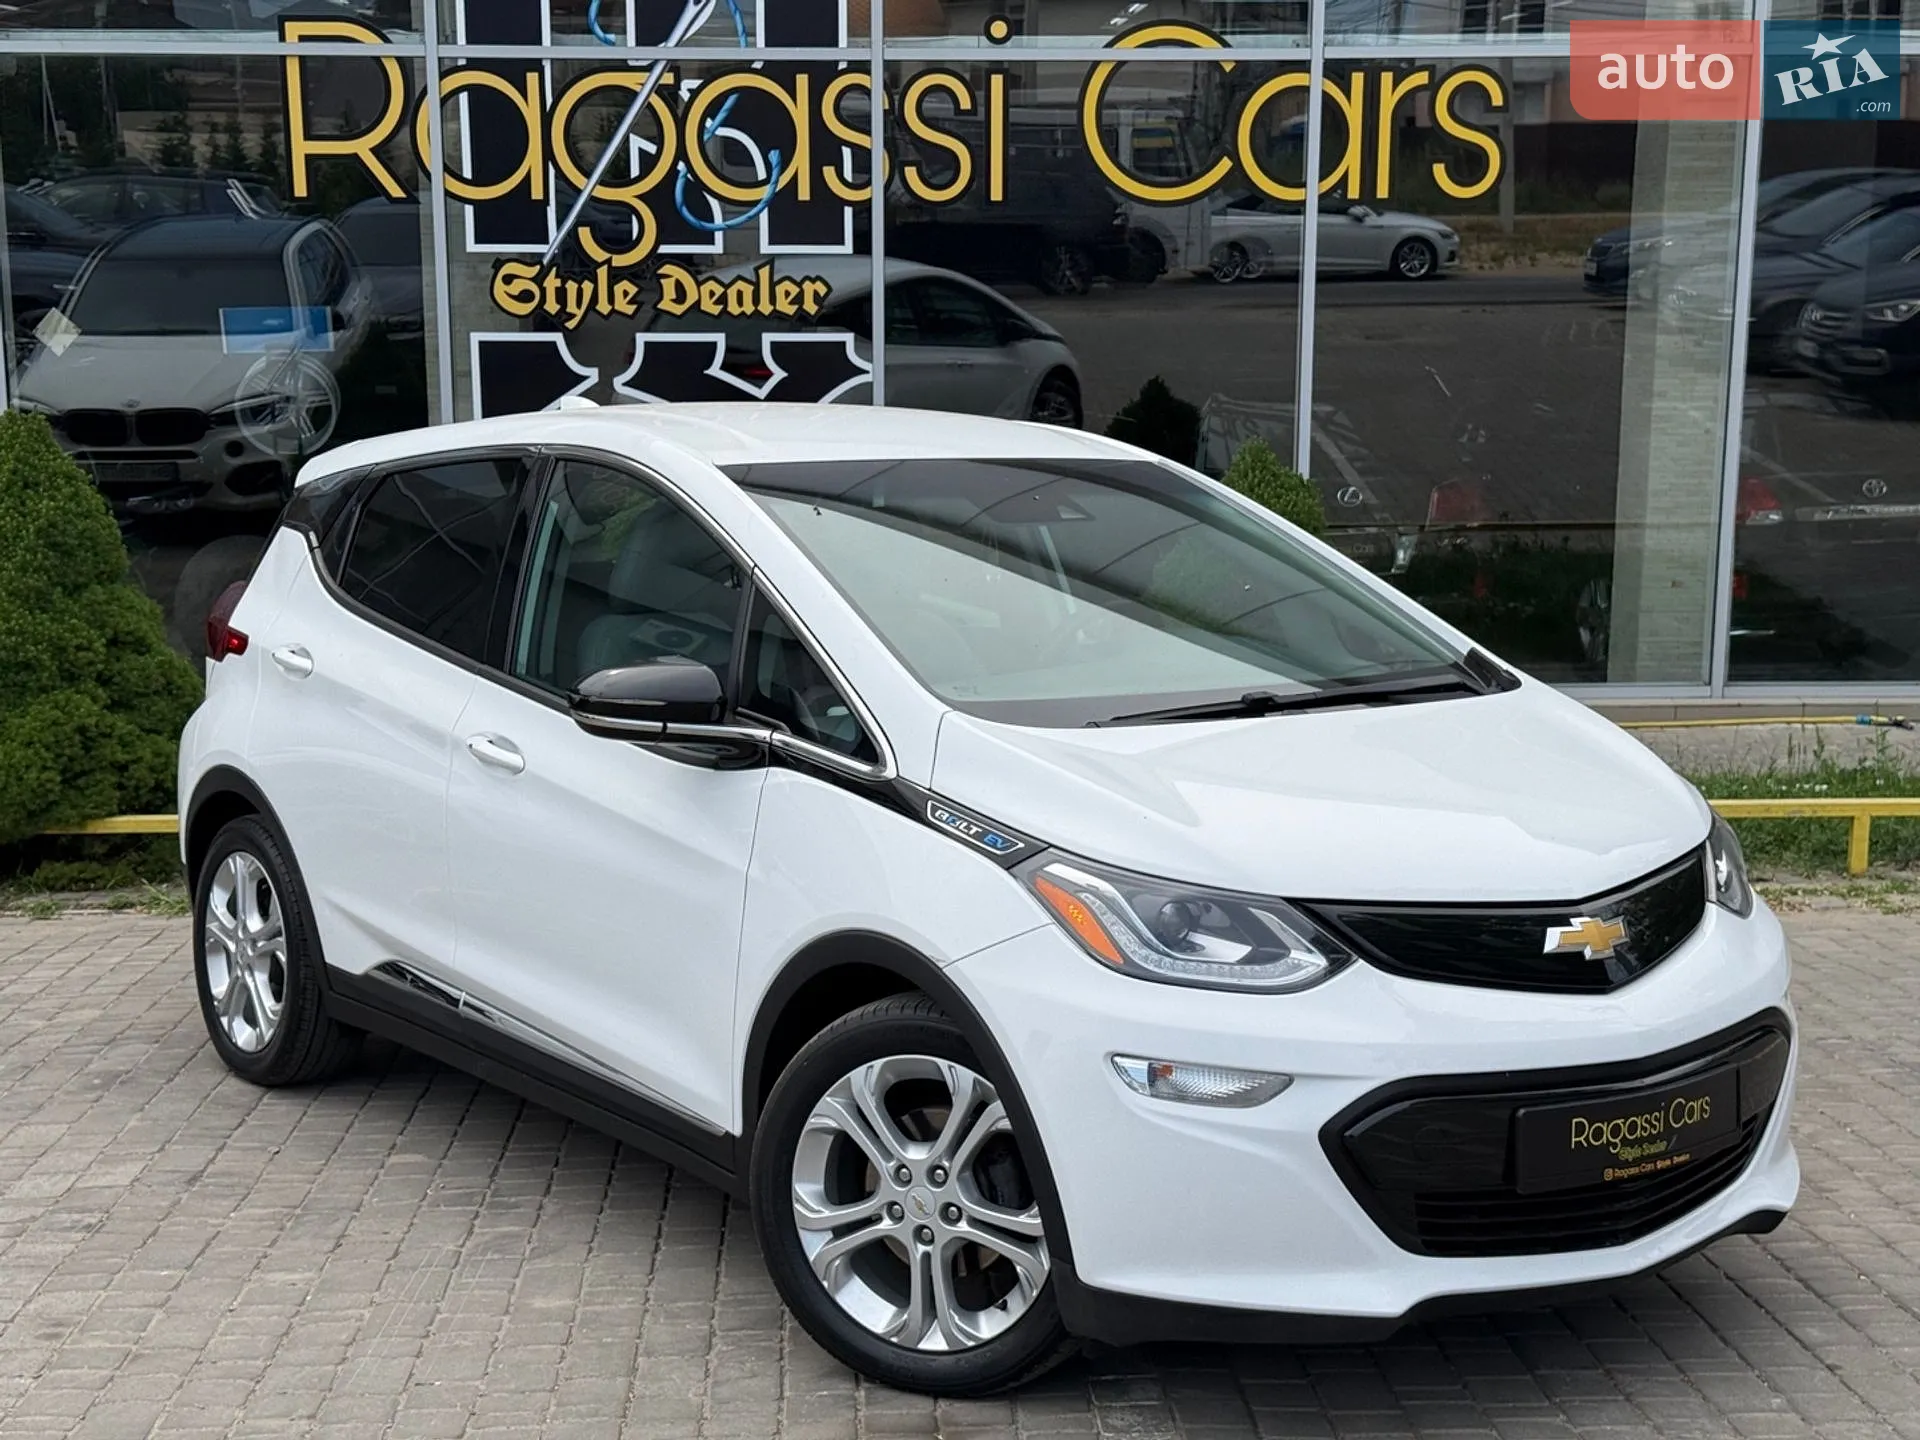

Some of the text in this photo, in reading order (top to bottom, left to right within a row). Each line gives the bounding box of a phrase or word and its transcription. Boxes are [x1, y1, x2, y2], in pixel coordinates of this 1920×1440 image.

[282, 20, 1504, 267] Ragassi Cars
[493, 261, 829, 330] Style Dealer
[935, 808, 1012, 849] BOLT EV
[1571, 1102, 1665, 1154] Ragassi
[1669, 1096, 1711, 1129] Cars
